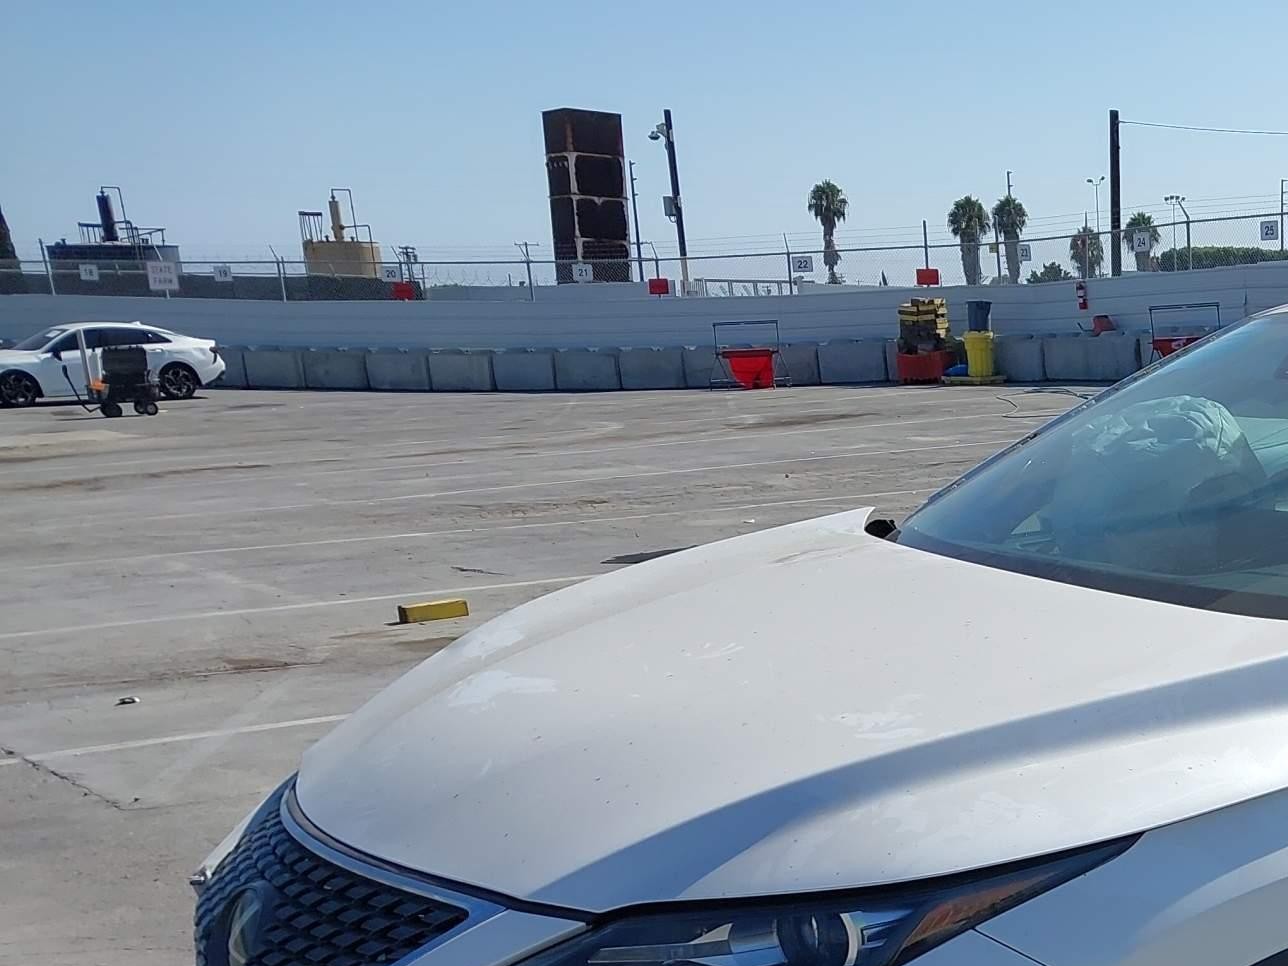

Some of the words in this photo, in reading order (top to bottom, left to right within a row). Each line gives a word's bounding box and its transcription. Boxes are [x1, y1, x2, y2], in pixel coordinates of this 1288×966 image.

[1264, 225, 1275, 236] 25
[1137, 237, 1146, 247] 24
[797, 259, 809, 269] 22
[386, 270, 396, 278] 20
[578, 268, 588, 277] 21
